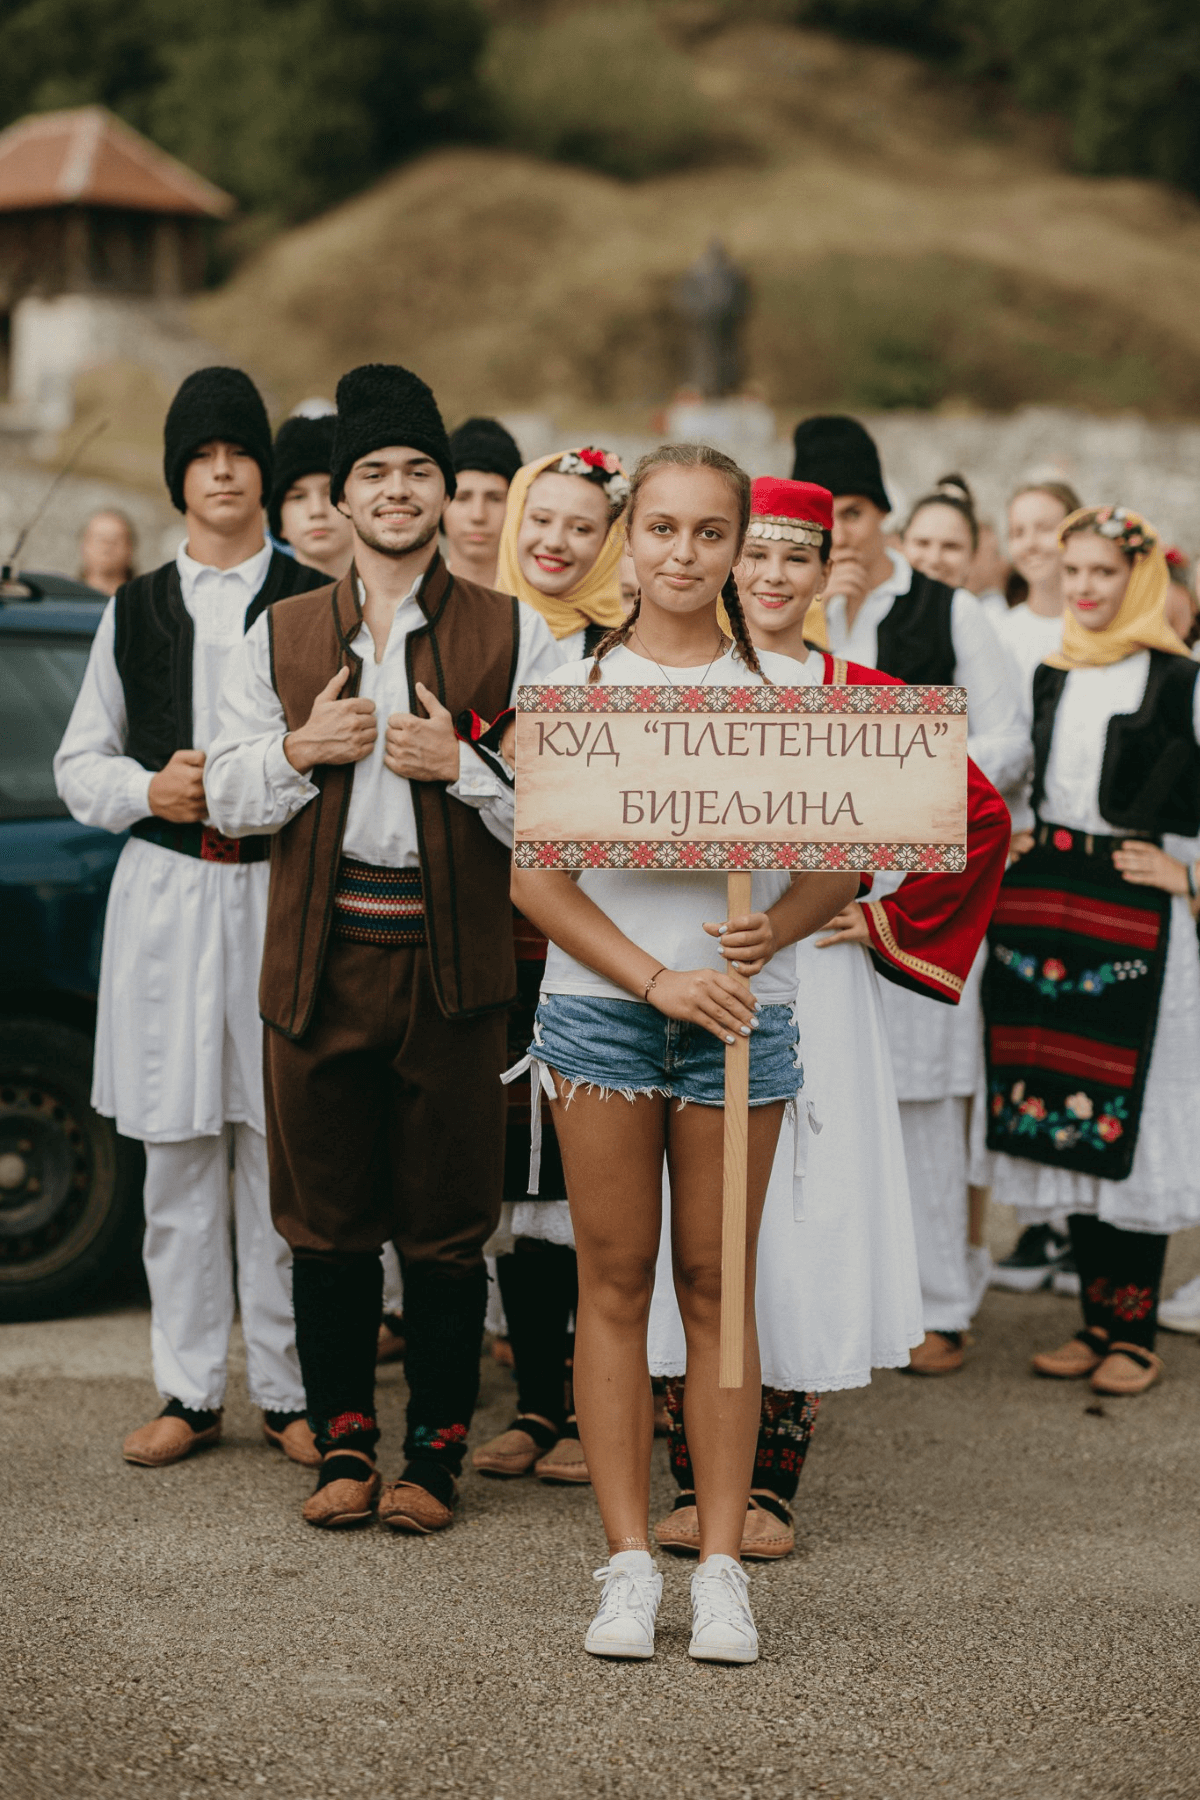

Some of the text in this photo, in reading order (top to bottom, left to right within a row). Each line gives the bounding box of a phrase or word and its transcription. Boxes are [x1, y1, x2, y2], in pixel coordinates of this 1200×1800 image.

[534, 720, 949, 769] КУД “ПЛЕТЕНИЦА”
[618, 790, 864, 837] БИЈЕЉИНА
